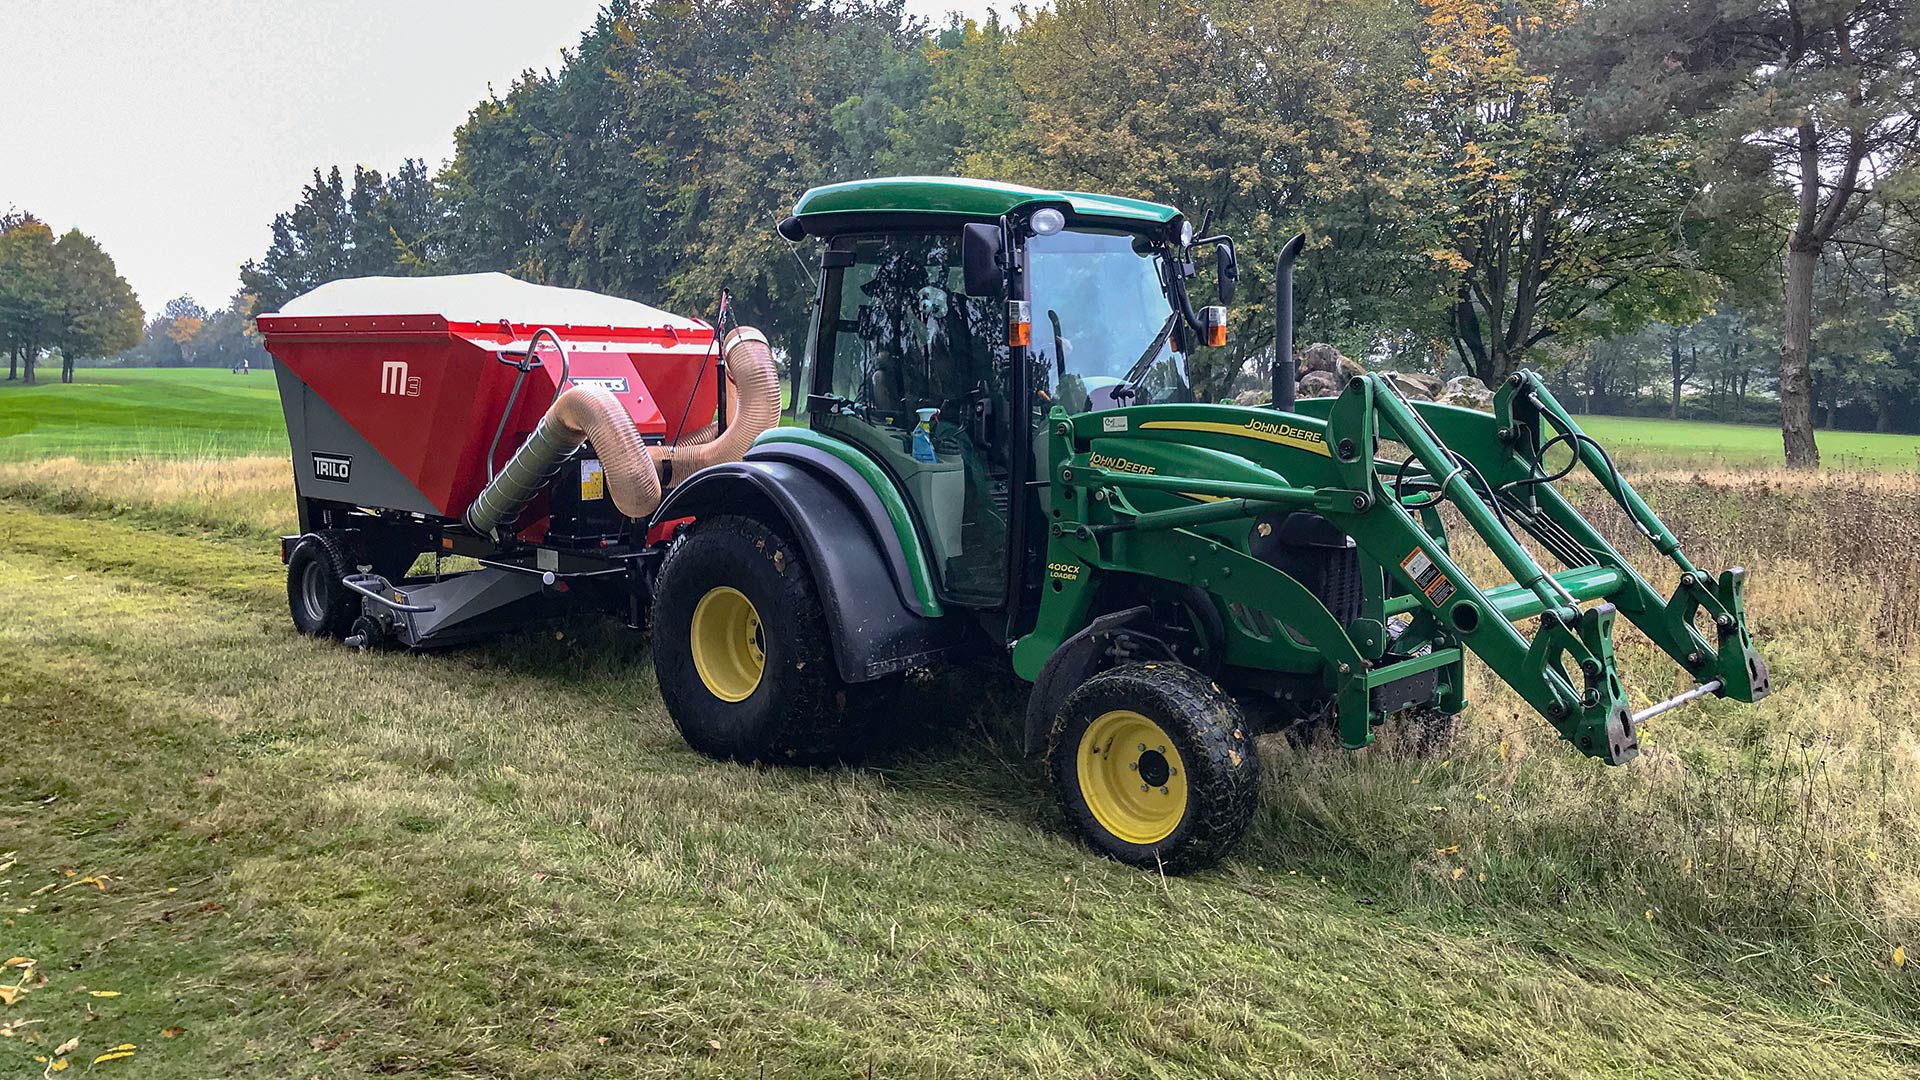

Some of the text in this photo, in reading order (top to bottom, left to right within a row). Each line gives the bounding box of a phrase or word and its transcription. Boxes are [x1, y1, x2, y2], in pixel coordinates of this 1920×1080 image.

[1244, 418, 1322, 442] JOHN DEERE
[314, 456, 350, 478] TRILO
[1115, 457, 1156, 476] DEERE
[1048, 562, 1080, 574] 400CX
[1050, 571, 1077, 581] LOADER
